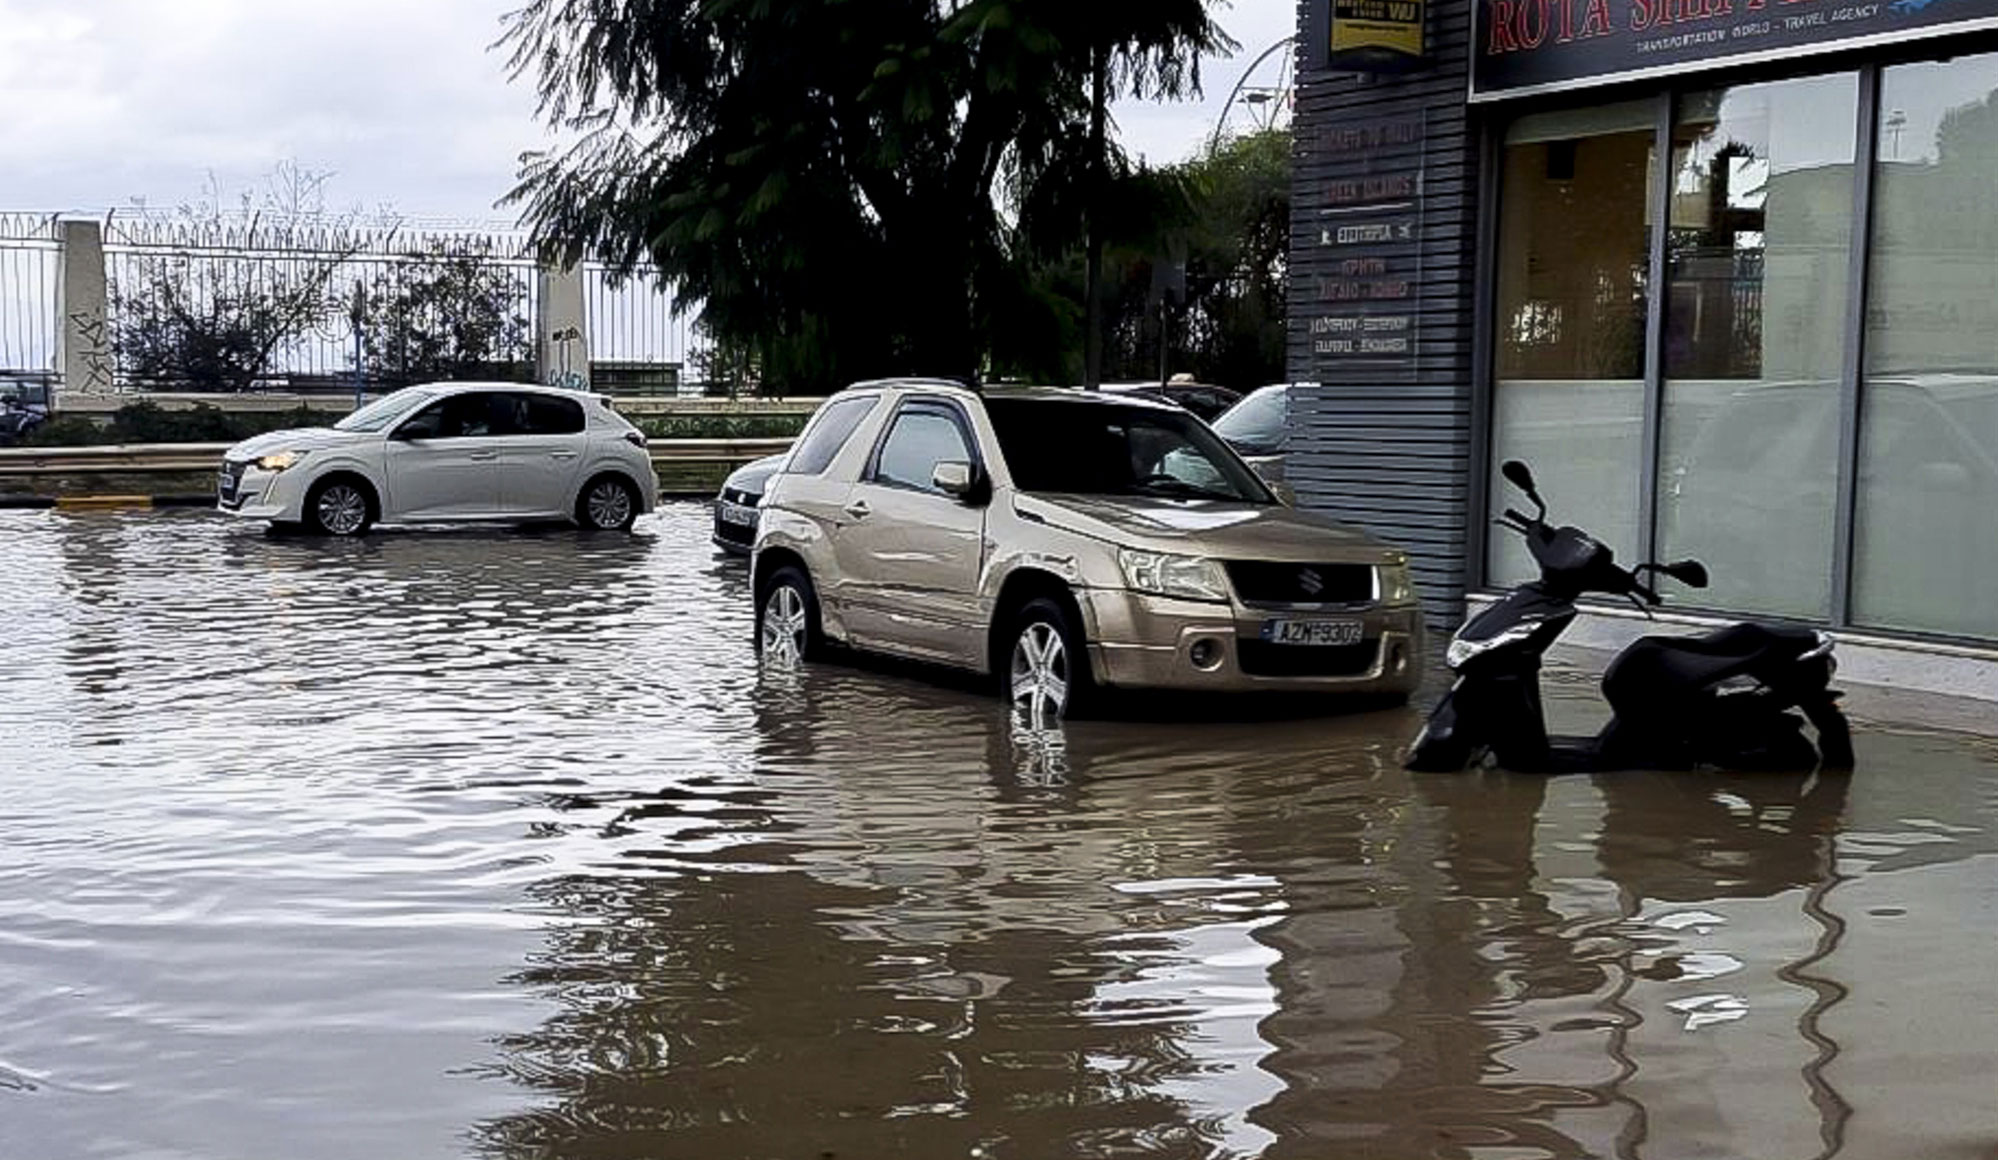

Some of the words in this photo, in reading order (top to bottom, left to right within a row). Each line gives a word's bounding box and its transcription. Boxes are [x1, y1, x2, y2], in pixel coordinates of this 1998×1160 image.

[1488, 0, 1612, 54] ROTA
[1785, 12, 1828, 30] TRAVEL
[1831, 4, 1879, 22] AGENCY
